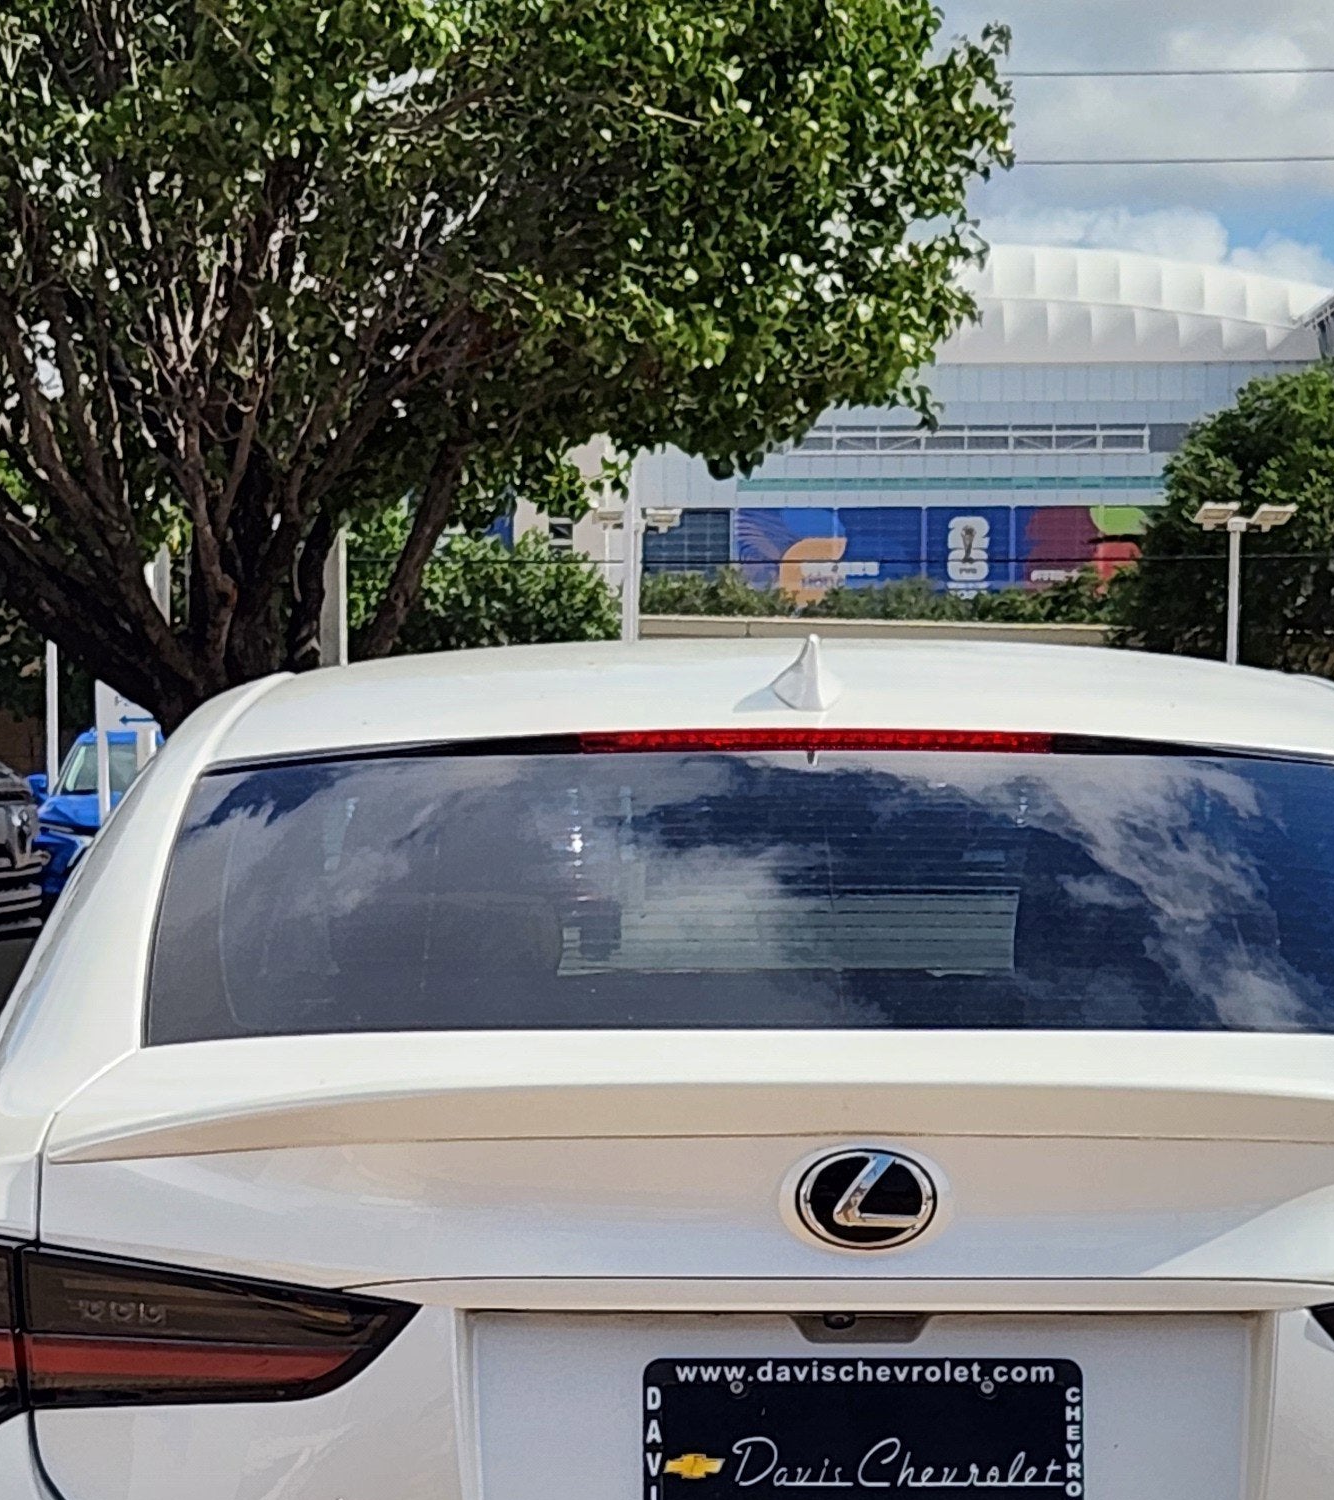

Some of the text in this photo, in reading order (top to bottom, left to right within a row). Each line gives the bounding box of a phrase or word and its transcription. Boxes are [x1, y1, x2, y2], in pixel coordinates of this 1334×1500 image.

[675, 1361, 1055, 1382] www.davischevrolet.com
[731, 1436, 1064, 1488] Davis Chevrolet
